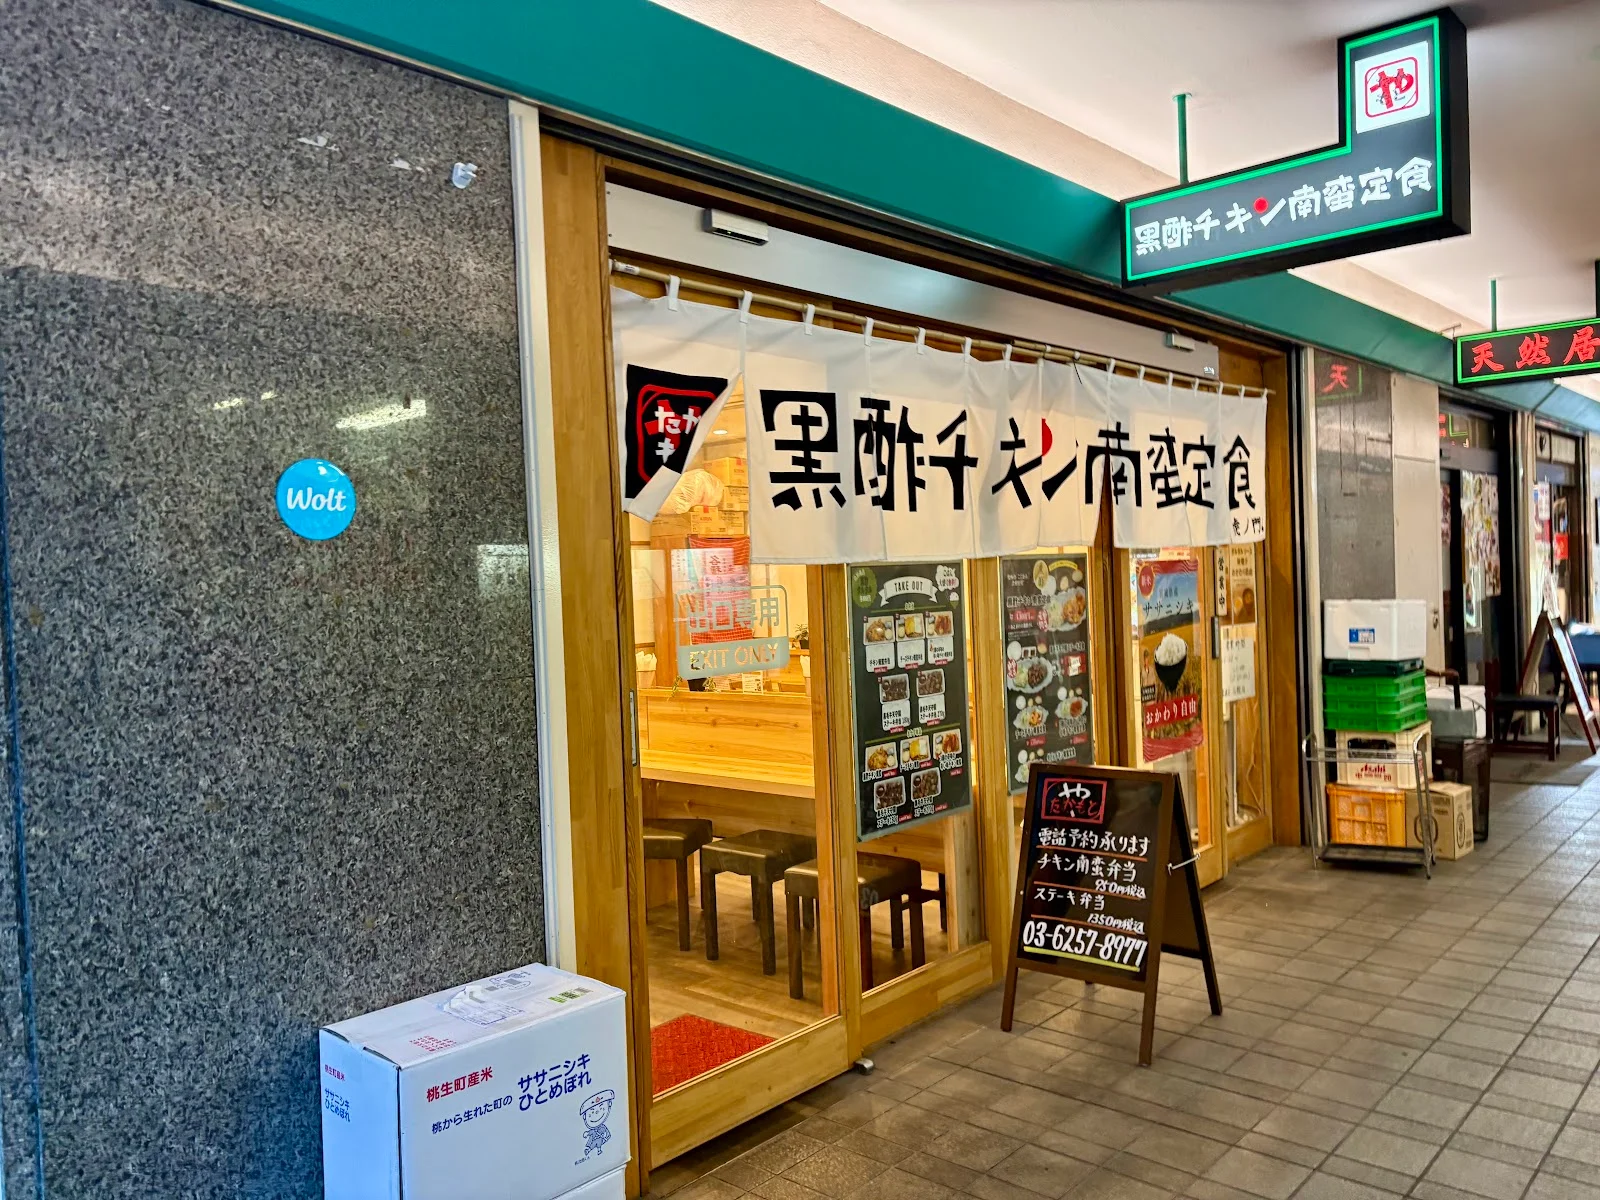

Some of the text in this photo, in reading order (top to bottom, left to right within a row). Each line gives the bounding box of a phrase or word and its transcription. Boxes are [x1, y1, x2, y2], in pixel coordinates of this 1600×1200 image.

[1134, 156, 1433, 256] 黒酢チキン南蛮定食
[1471, 326, 1600, 373] 天然居
[286, 487, 347, 512] Wolt
[894, 580, 923, 592] TAKE OUT
[687, 597, 780, 633] 出口専用
[1143, 597, 1194, 618] ササニシキ
[690, 642, 779, 671] EXIT ONLY
[1146, 697, 1196, 725] おかわり自由
[1036, 853, 1137, 883] チキン南蛮弁当
[1034, 887, 1105, 911] ステーキ弁当
[1023, 920, 1147, 967] 03-6257-8977
[426, 1066, 493, 1103] 桃生町産米
[517, 1053, 591, 1094] ササニシキ
[325, 1087, 350, 1111] ササニシキ
[518, 1071, 592, 1112] ひとめぼれ
[325, 1098, 351, 1123] ひとめぼれ
[431, 1094, 513, 1135] 桃から生れた町の
